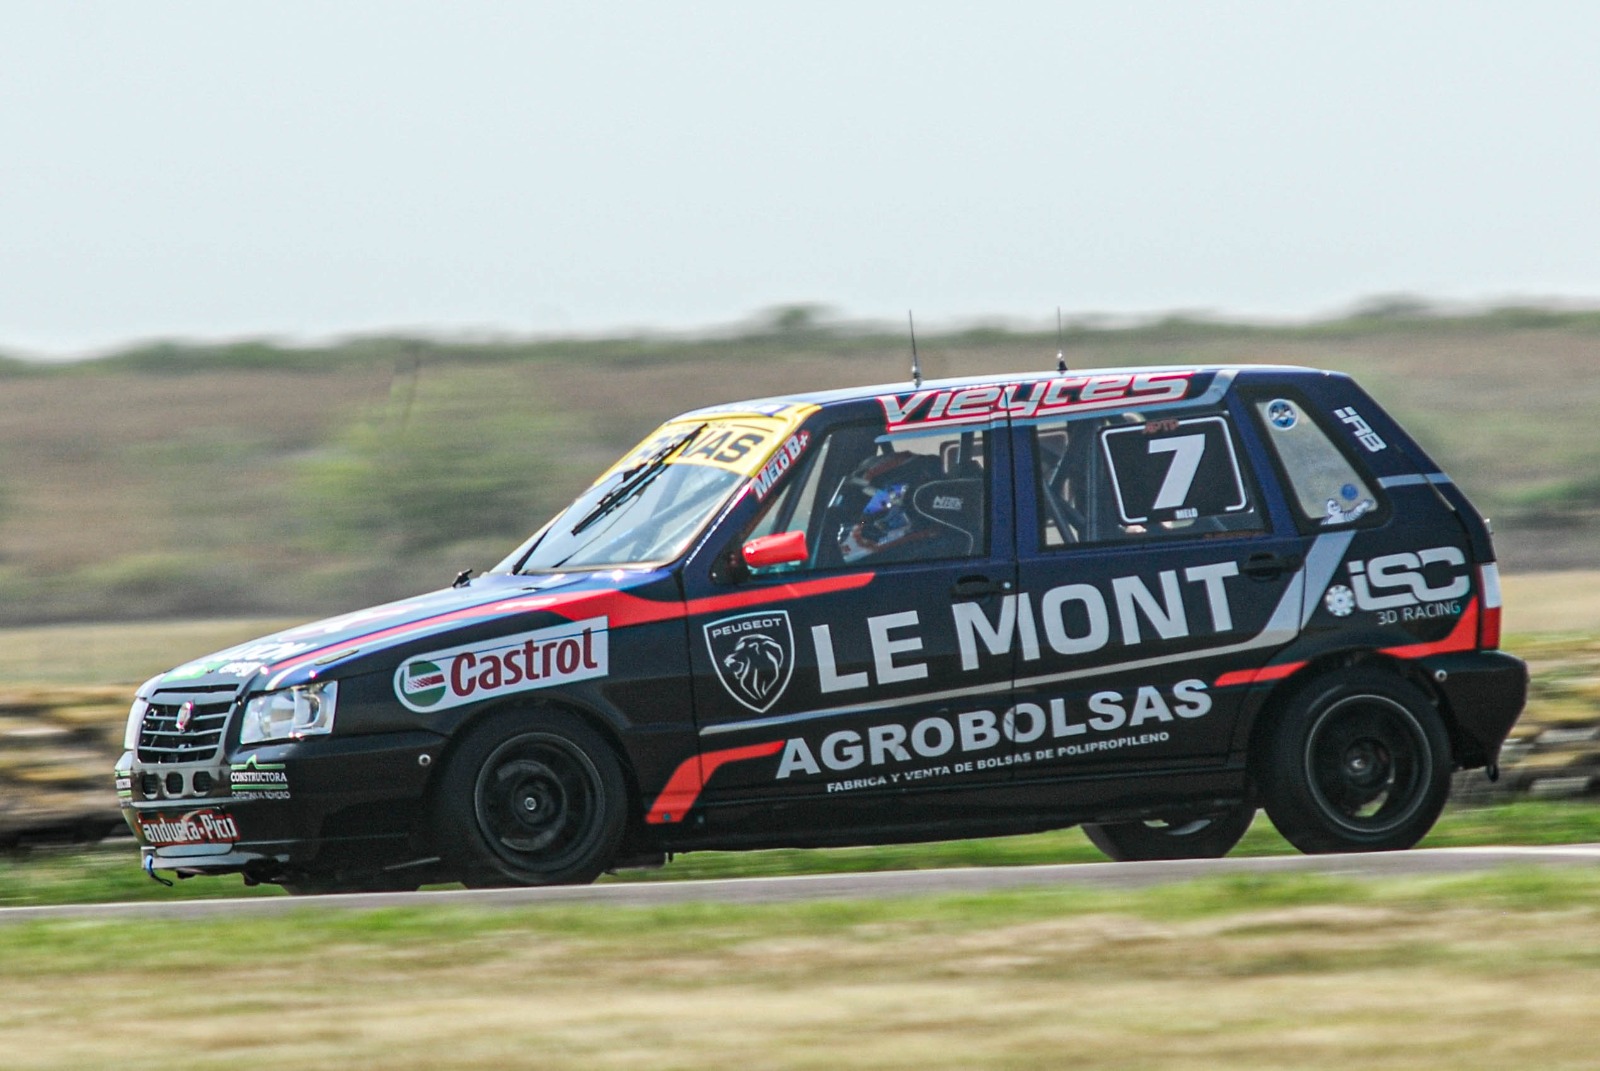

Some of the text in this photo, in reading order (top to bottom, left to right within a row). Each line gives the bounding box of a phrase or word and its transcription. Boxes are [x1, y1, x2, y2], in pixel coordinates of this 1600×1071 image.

[1147, 433, 1206, 510] 7
[711, 617, 783, 639] PEUGEOT
[811, 560, 1240, 694] LE MONT
[1377, 599, 1462, 626] 3D RACING
[450, 627, 599, 697] Castrol
[775, 678, 1213, 780] AGROBOLSAS
[230, 771, 288, 783] CONSTRUCTORA
[826, 731, 1170, 794] FABRICA Y VENTA DE BOLSAS DE POLIPROPILENO
